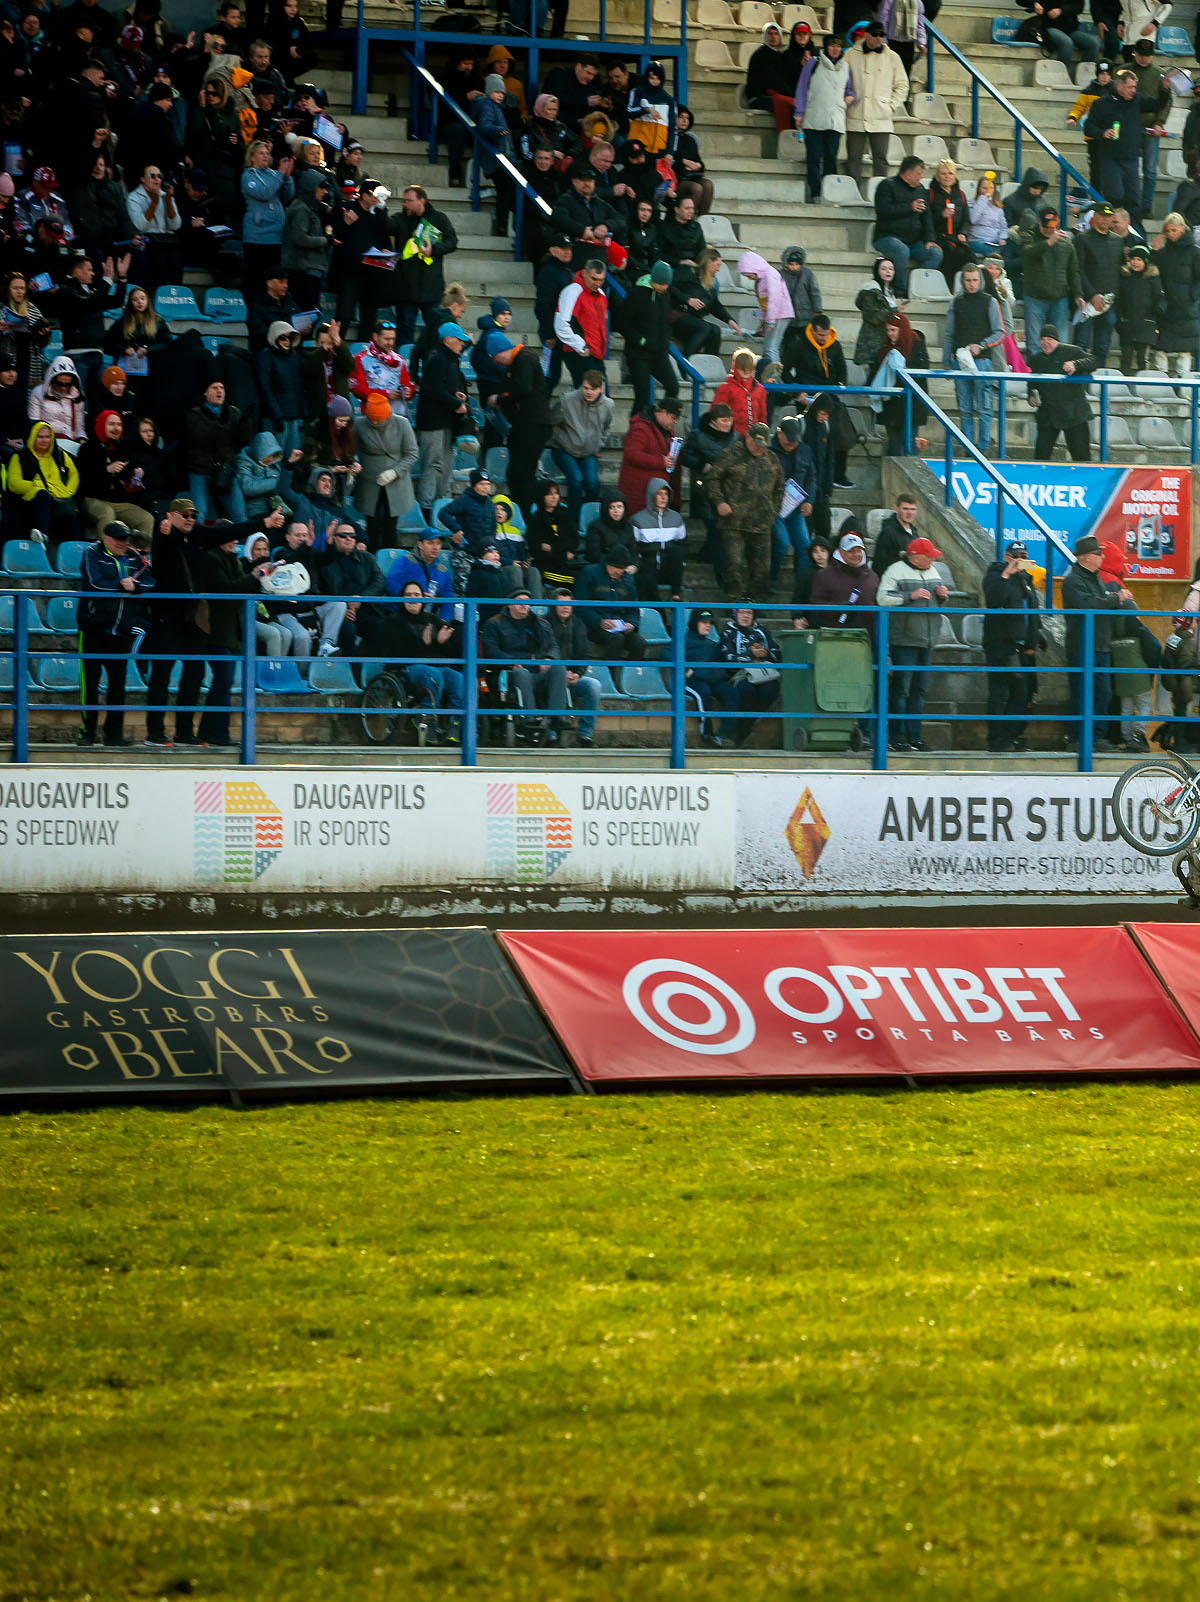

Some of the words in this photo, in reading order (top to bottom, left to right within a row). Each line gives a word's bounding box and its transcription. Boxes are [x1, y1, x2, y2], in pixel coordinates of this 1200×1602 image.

[1131, 490, 1179, 503] ORIGINAL
[1161, 477, 1180, 490] THE
[1122, 503, 1160, 515] MOTOR
[1162, 504, 1180, 516] OIL
[0, 782, 130, 809] AUGAVPILS
[293, 783, 426, 810] DAUGAVPILS
[582, 785, 710, 811] DAUGAVPILS
[878, 796, 1015, 842] AMBER
[16, 819, 120, 846] SPEEDWAY
[293, 820, 312, 846] IR
[319, 820, 391, 846] SPORTS
[583, 821, 600, 846] IS
[606, 821, 701, 846] SPEEDWAY
[907, 856, 1162, 876] WWW.AMBER-STUDIOS.COM
[13, 947, 320, 1004] YOGGI
[763, 964, 1082, 1024] OPTIBET
[46, 1003, 330, 1029] GASTROBĀRS
[791, 1027, 969, 1045] SPORTA
[995, 1025, 1105, 1043] BĀRS
[100, 1026, 335, 1080] BEAR
